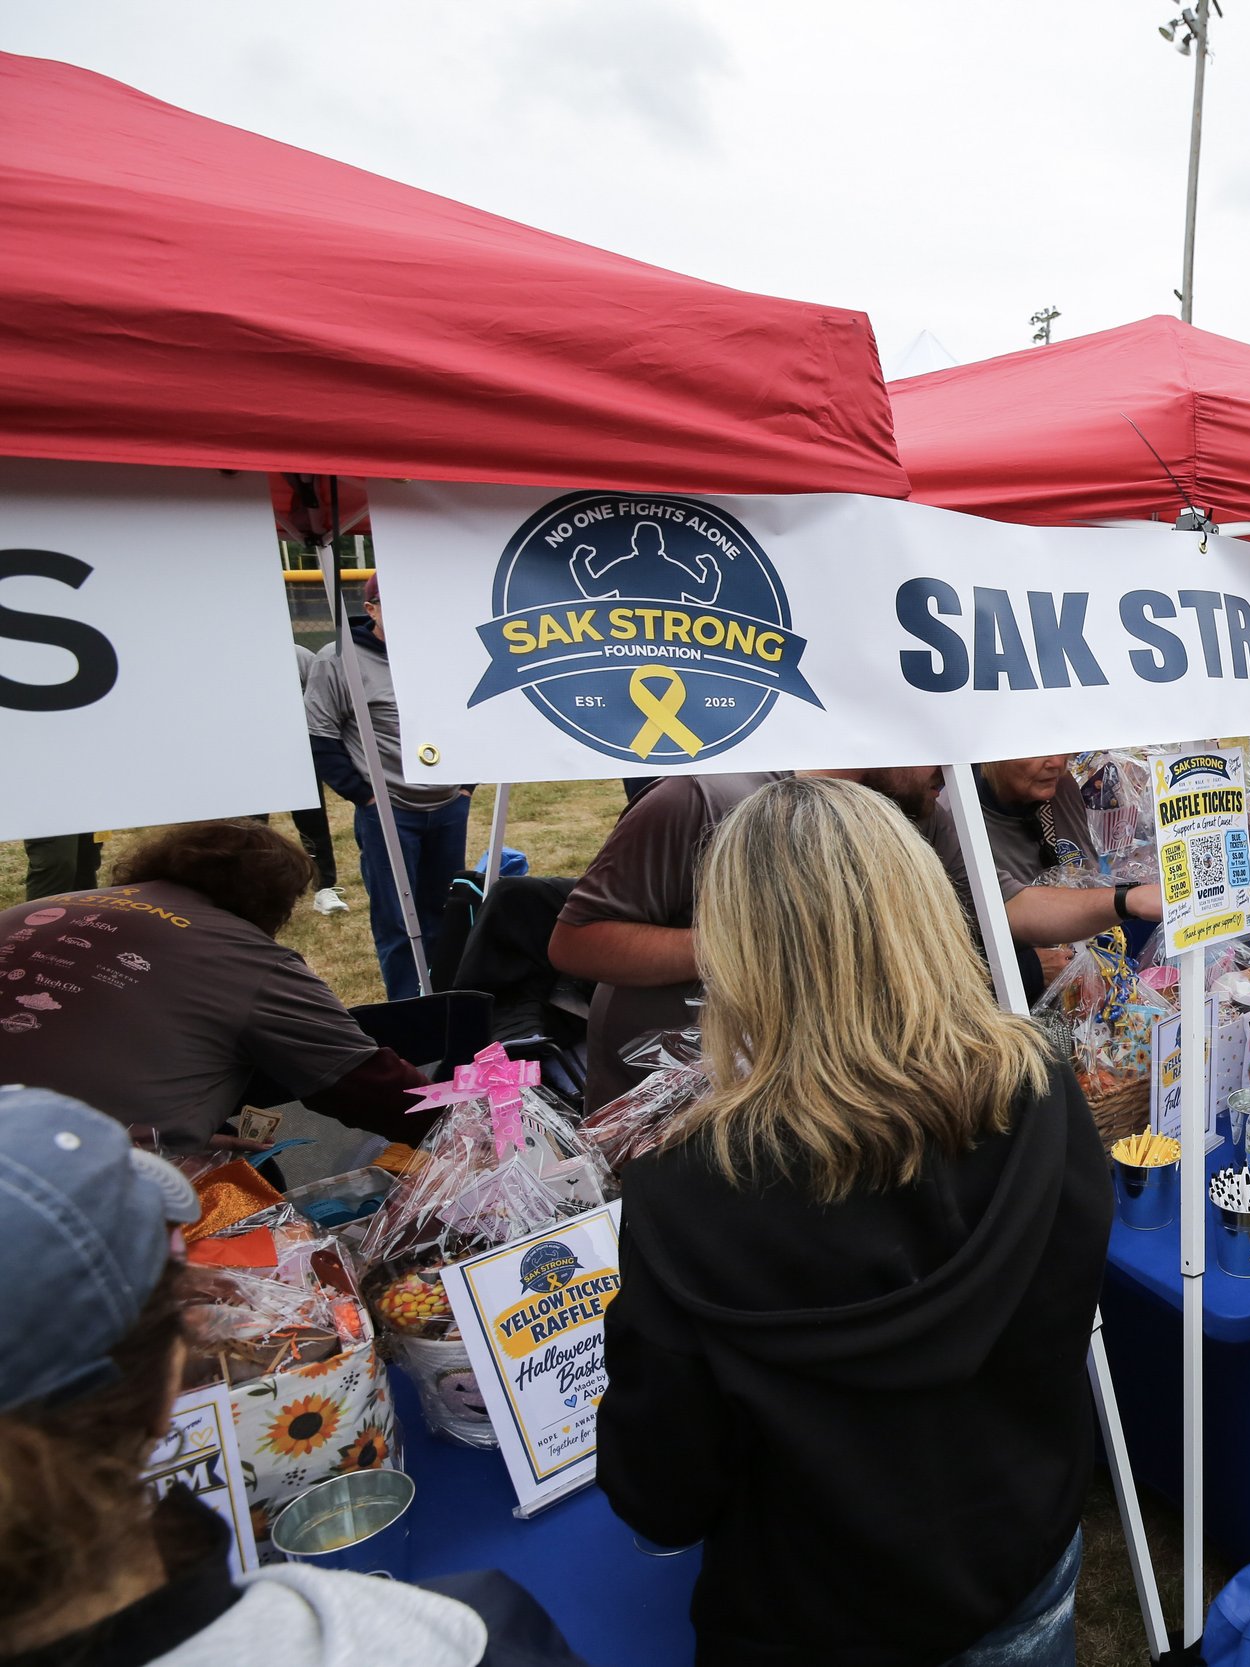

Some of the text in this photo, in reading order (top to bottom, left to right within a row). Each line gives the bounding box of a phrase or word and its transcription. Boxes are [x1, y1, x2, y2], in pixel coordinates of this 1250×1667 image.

[545, 502, 741, 560] NO ONE FIGHTS ALONE
[502, 607, 785, 662] SAK STRONG
[896, 577, 1110, 693] SAK
[604, 645, 701, 660] FOUNDATION
[575, 695, 736, 708] EST. 2025
[1174, 757, 1223, 775] SAK STRONG
[1160, 791, 1242, 826] RAFFLE TICKETS
[1173, 820, 1195, 837] Support
[1202, 817, 1216, 830] Great
[1218, 815, 1233, 827] Cause!
[1232, 833, 1241, 841] BLUE
[1165, 844, 1180, 855] YELLOW
[1166, 851, 1181, 863] TICKETS
[1232, 852, 1244, 860] $5.00
[1169, 864, 1182, 875] $5.00
[1233, 870, 1246, 878] $10.00
[1171, 881, 1186, 893] $10.00
[1198, 885, 1224, 899] venmo
[80, 895, 192, 928] STRONG
[1183, 926, 1196, 941] Thank
[1212, 924, 1221, 935] your
[1163, 1053, 1181, 1074] YELL
[524, 1258, 574, 1283] SAK STRONG
[500, 1274, 621, 1338] YELLOW TICKET
[530, 1298, 604, 1343] RAFFLE
[515, 1333, 605, 1391] Halloween
[556, 1353, 605, 1394] Baske
[574, 1374, 606, 1393] Made by
[583, 1384, 605, 1401] Ava
[538, 1433, 558, 1447] HOPE
[547, 1435, 579, 1456] Together
[580, 1429, 591, 1442] for
